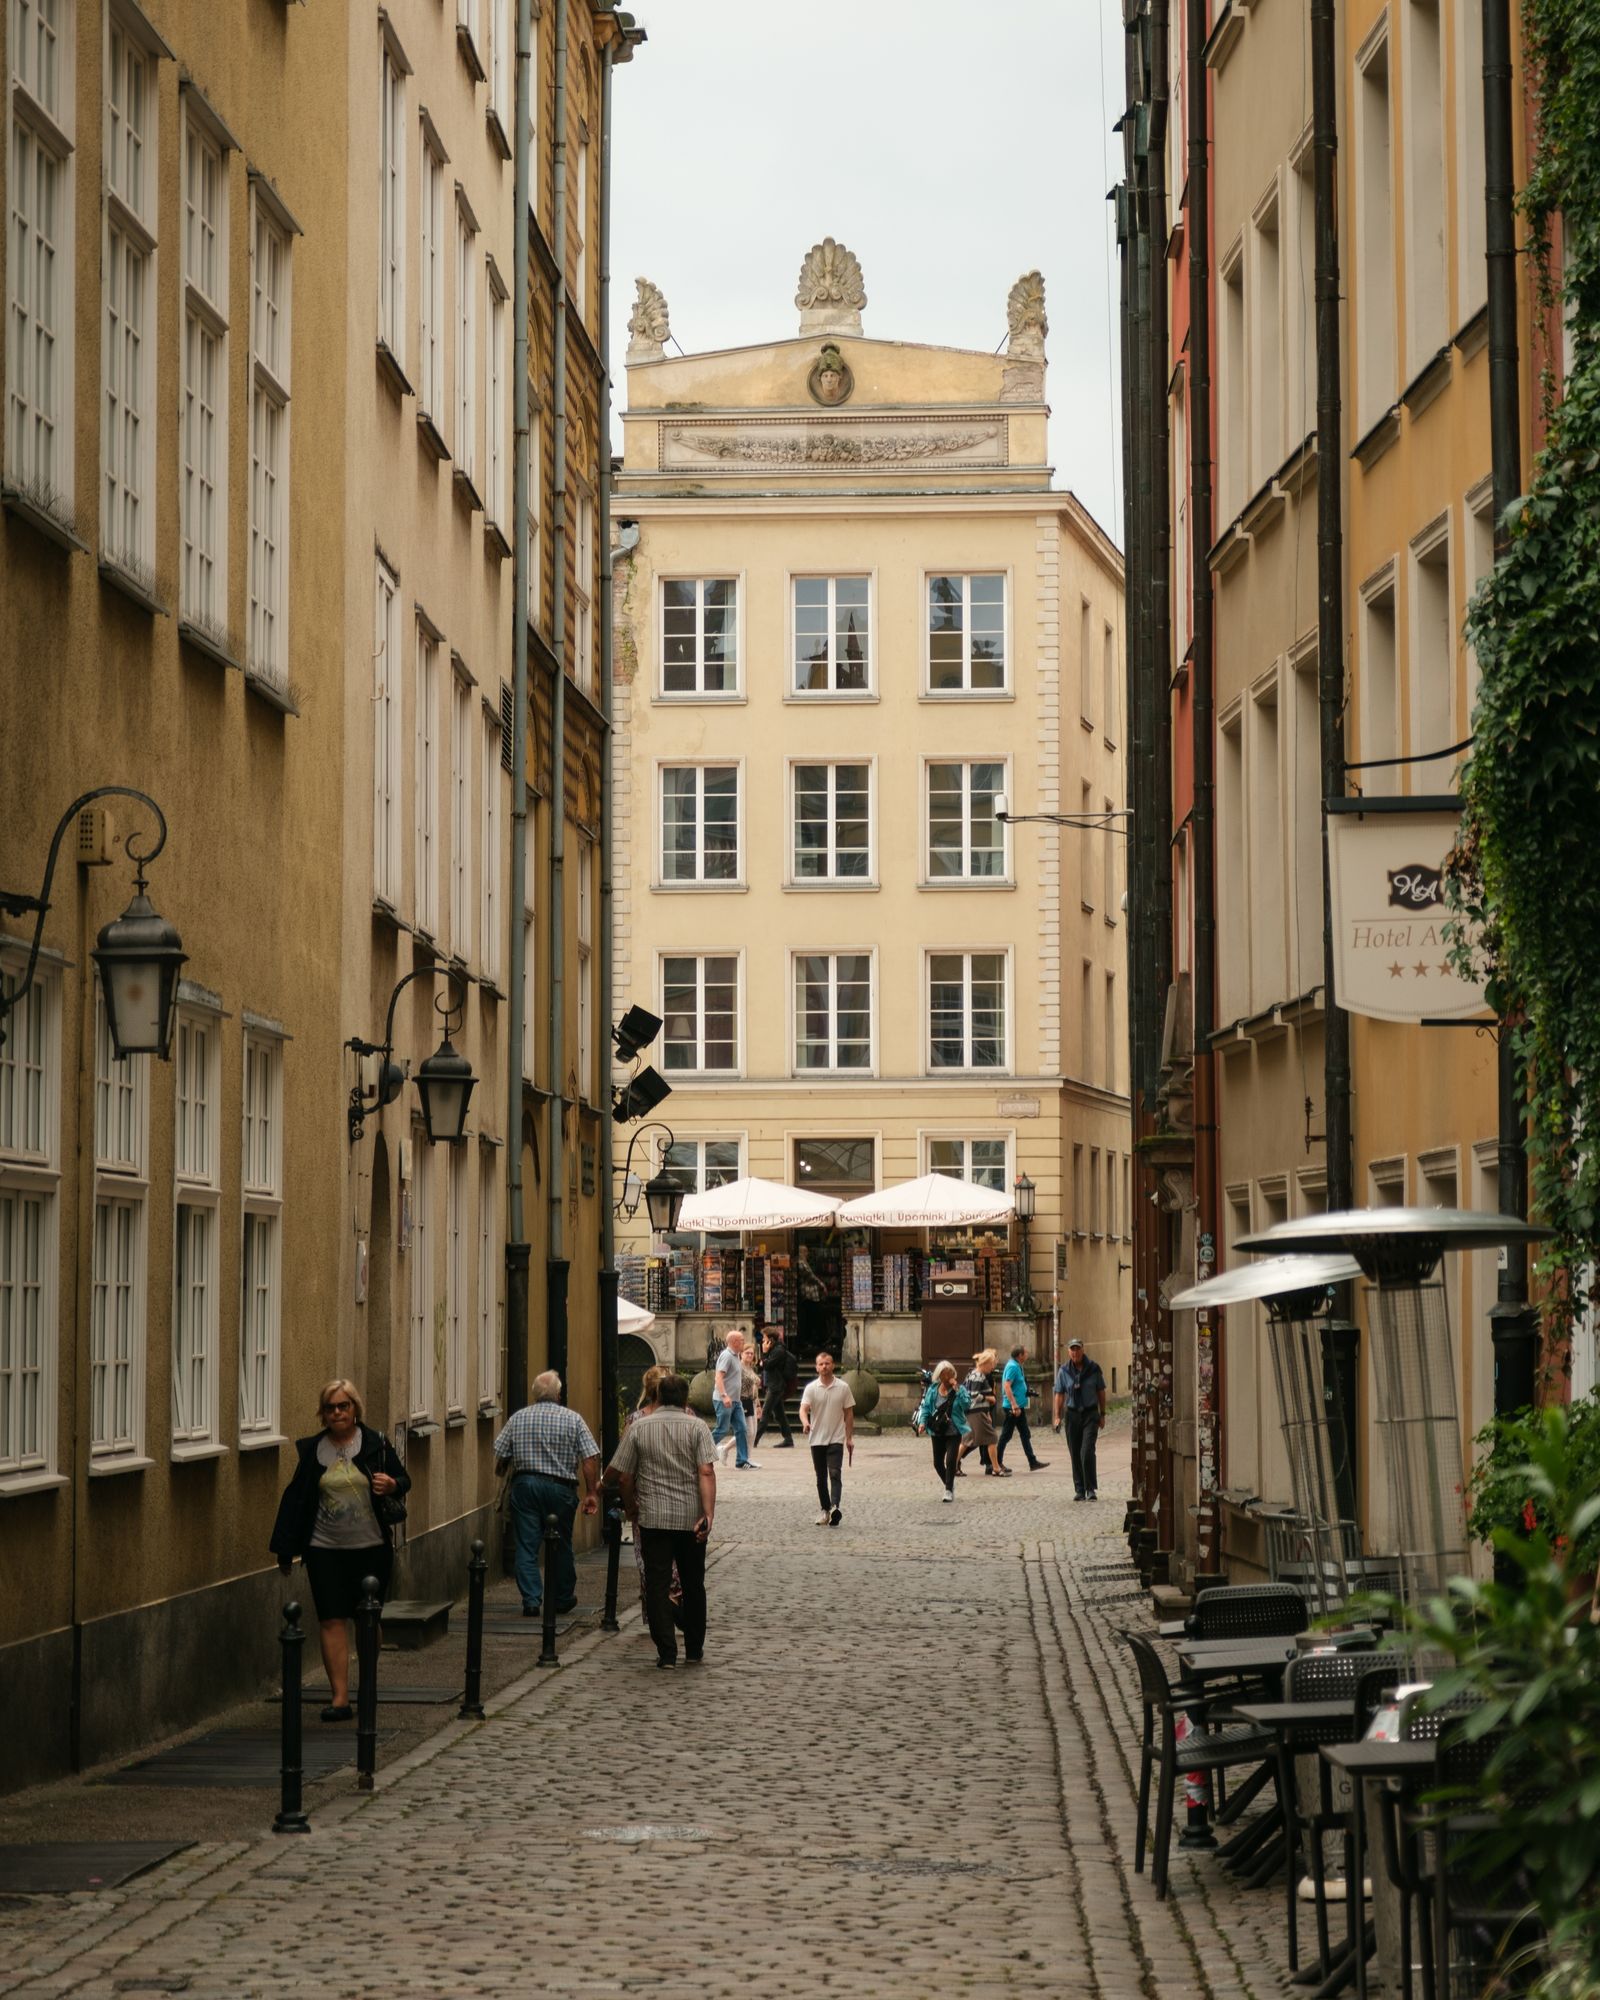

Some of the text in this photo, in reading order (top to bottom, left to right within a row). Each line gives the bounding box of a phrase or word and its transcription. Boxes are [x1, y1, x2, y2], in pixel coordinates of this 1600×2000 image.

[1352, 925, 1412, 949] Hotel
[717, 1216, 767, 1227] Upominki
[897, 1211, 947, 1222] Upominki
